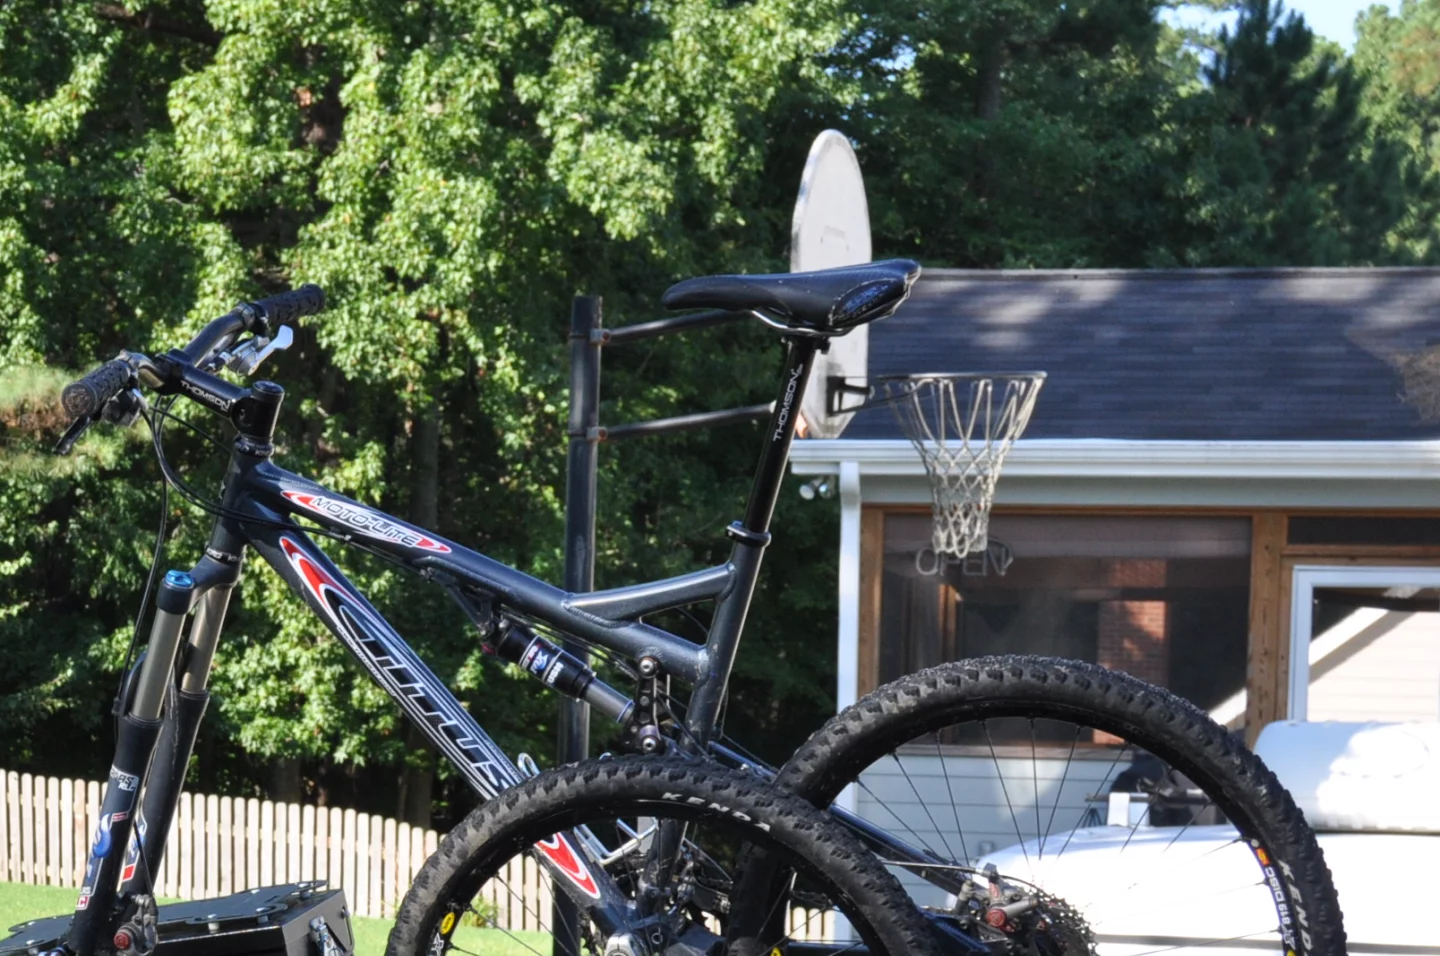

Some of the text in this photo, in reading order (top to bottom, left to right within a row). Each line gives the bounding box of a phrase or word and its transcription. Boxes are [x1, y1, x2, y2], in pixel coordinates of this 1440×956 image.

[180, 380, 231, 412] THOMSON
[772, 364, 803, 441] THOMSON
[312, 496, 419, 548] MOTO-LITE
[916, 547, 1006, 576] OPEN
[661, 791, 771, 833] KENDA
[1265, 866, 1285, 902] DISC
[1278, 903, 1291, 925] 819
